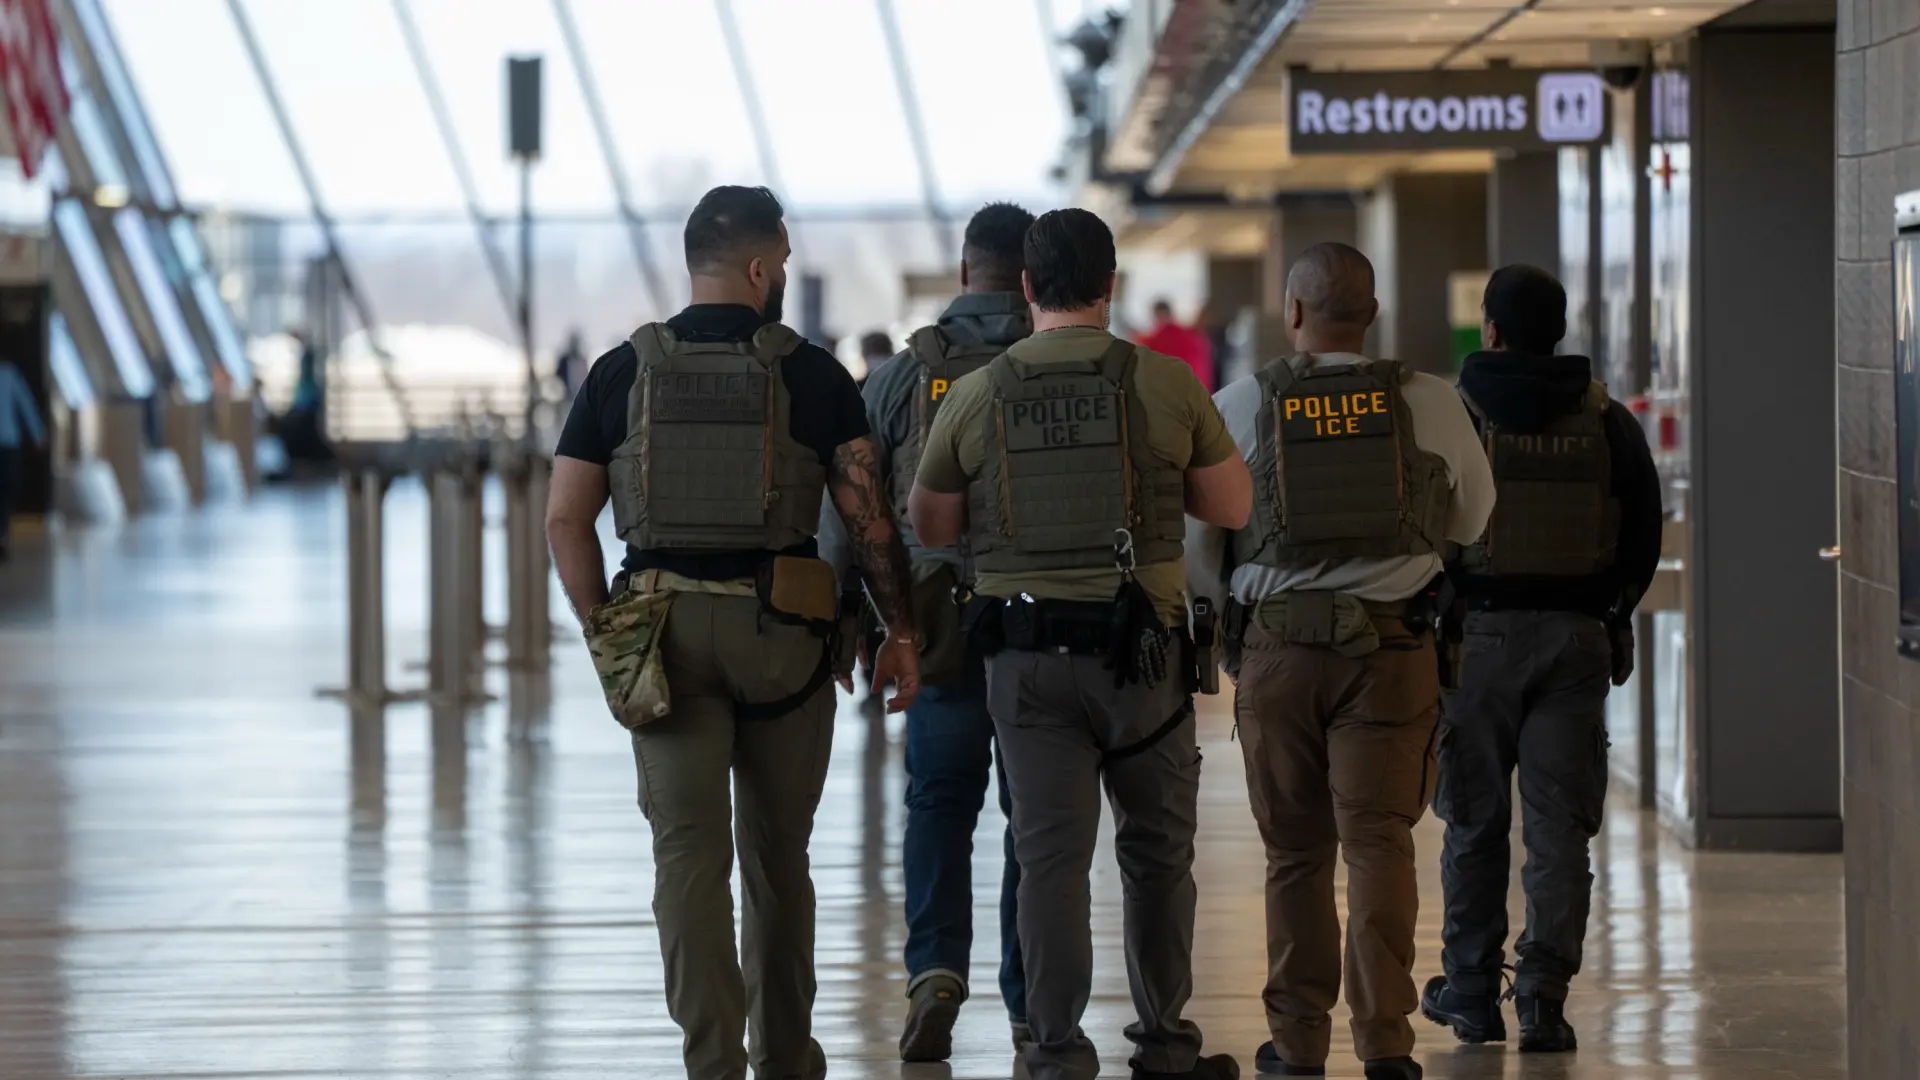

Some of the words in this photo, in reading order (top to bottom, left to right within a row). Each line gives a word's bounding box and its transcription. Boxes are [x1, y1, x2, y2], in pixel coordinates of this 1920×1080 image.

[1297, 91, 1527, 134] Restrooms
[1012, 397, 1110, 427] POLICE
[1284, 392, 1388, 420] POLICE
[1042, 424, 1082, 445] ICE
[1315, 417, 1361, 436] ICE
